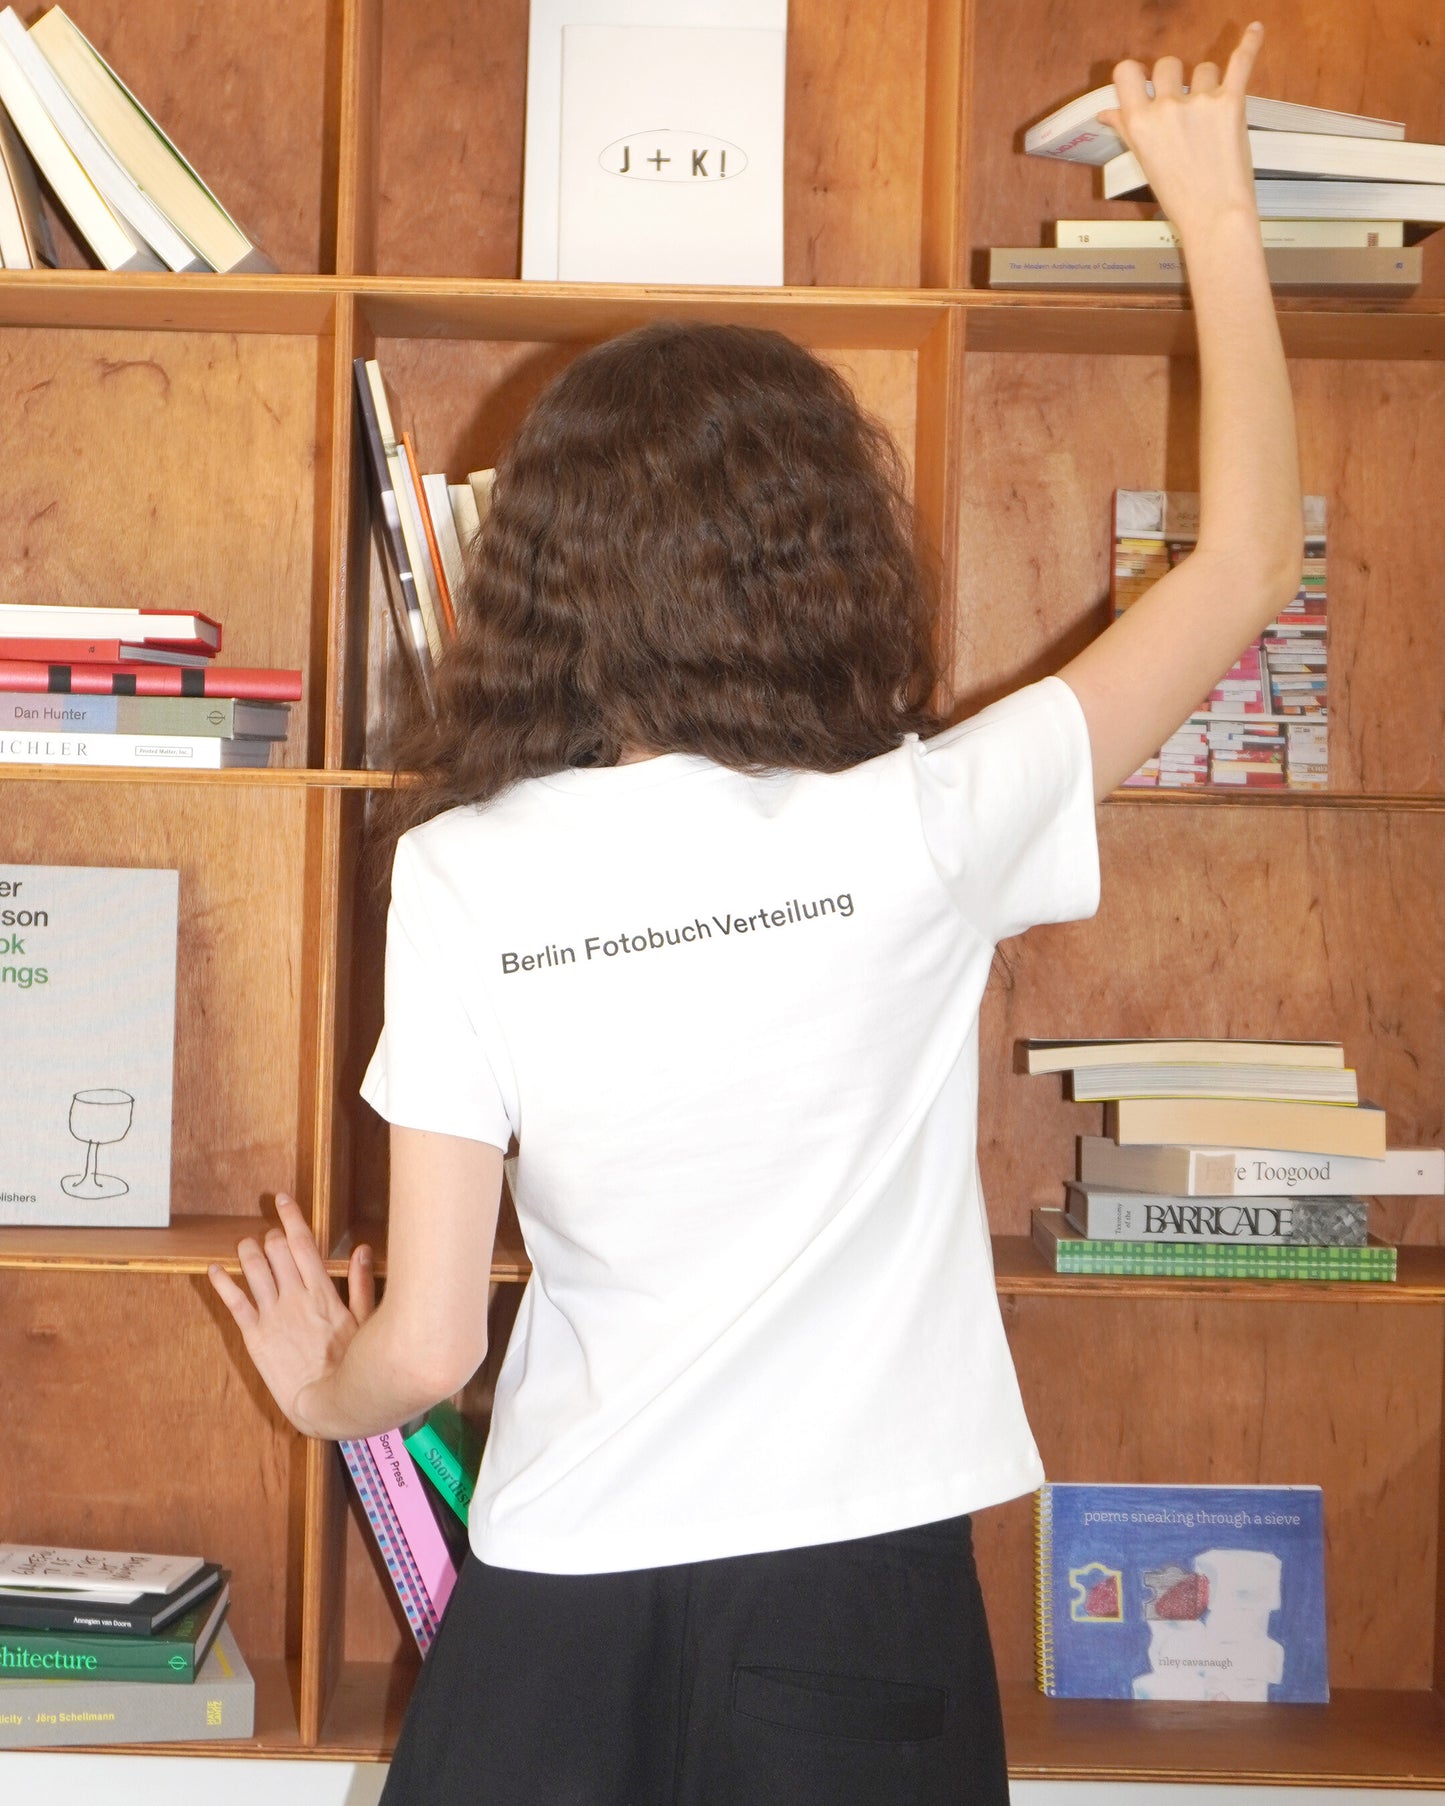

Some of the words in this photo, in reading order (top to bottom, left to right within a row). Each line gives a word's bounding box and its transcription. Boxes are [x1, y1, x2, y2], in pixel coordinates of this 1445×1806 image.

[620, 146, 630, 173] J
[692, 149, 726, 178] K!
[1010, 262, 1022, 270] The
[1024, 262, 1049, 270] Modern
[1052, 262, 1091, 270] Architecture
[1093, 262, 1101, 270] of
[14, 706, 39, 719] Dan
[43, 708, 87, 721] Hunter
[0, 881, 22, 898] er
[2, 909, 49, 927] son
[501, 944, 576, 975] Berlin
[584, 919, 712, 960] Fotobuch
[711, 893, 855, 936] Verteilung
[2, 966, 49, 989] ngs
[1252, 1161, 1331, 1187] Toogood
[0, 1191, 37, 1203] lishers
[1143, 1204, 1294, 1237] BARRICADE
[379, 1434, 395, 1460] Sorry
[390, 1460, 405, 1488] Press
[424, 1447, 472, 1508] Shortlist
[1085, 1511, 1129, 1526] poems
[1131, 1510, 1195, 1528] sneaking
[1196, 1510, 1251, 1528] through
[1254, 1514, 1261, 1525] a
[1264, 1512, 1301, 1526] sieve
[113, 1619, 132, 1628] Doorn
[0, 1646, 98, 1671] hitecture
[1159, 1656, 1180, 1669] riley
[1182, 1657, 1233, 1670] cavanaugh
[36, 1713, 57, 1724] Jörg
[59, 1712, 115, 1722] Schellmann
